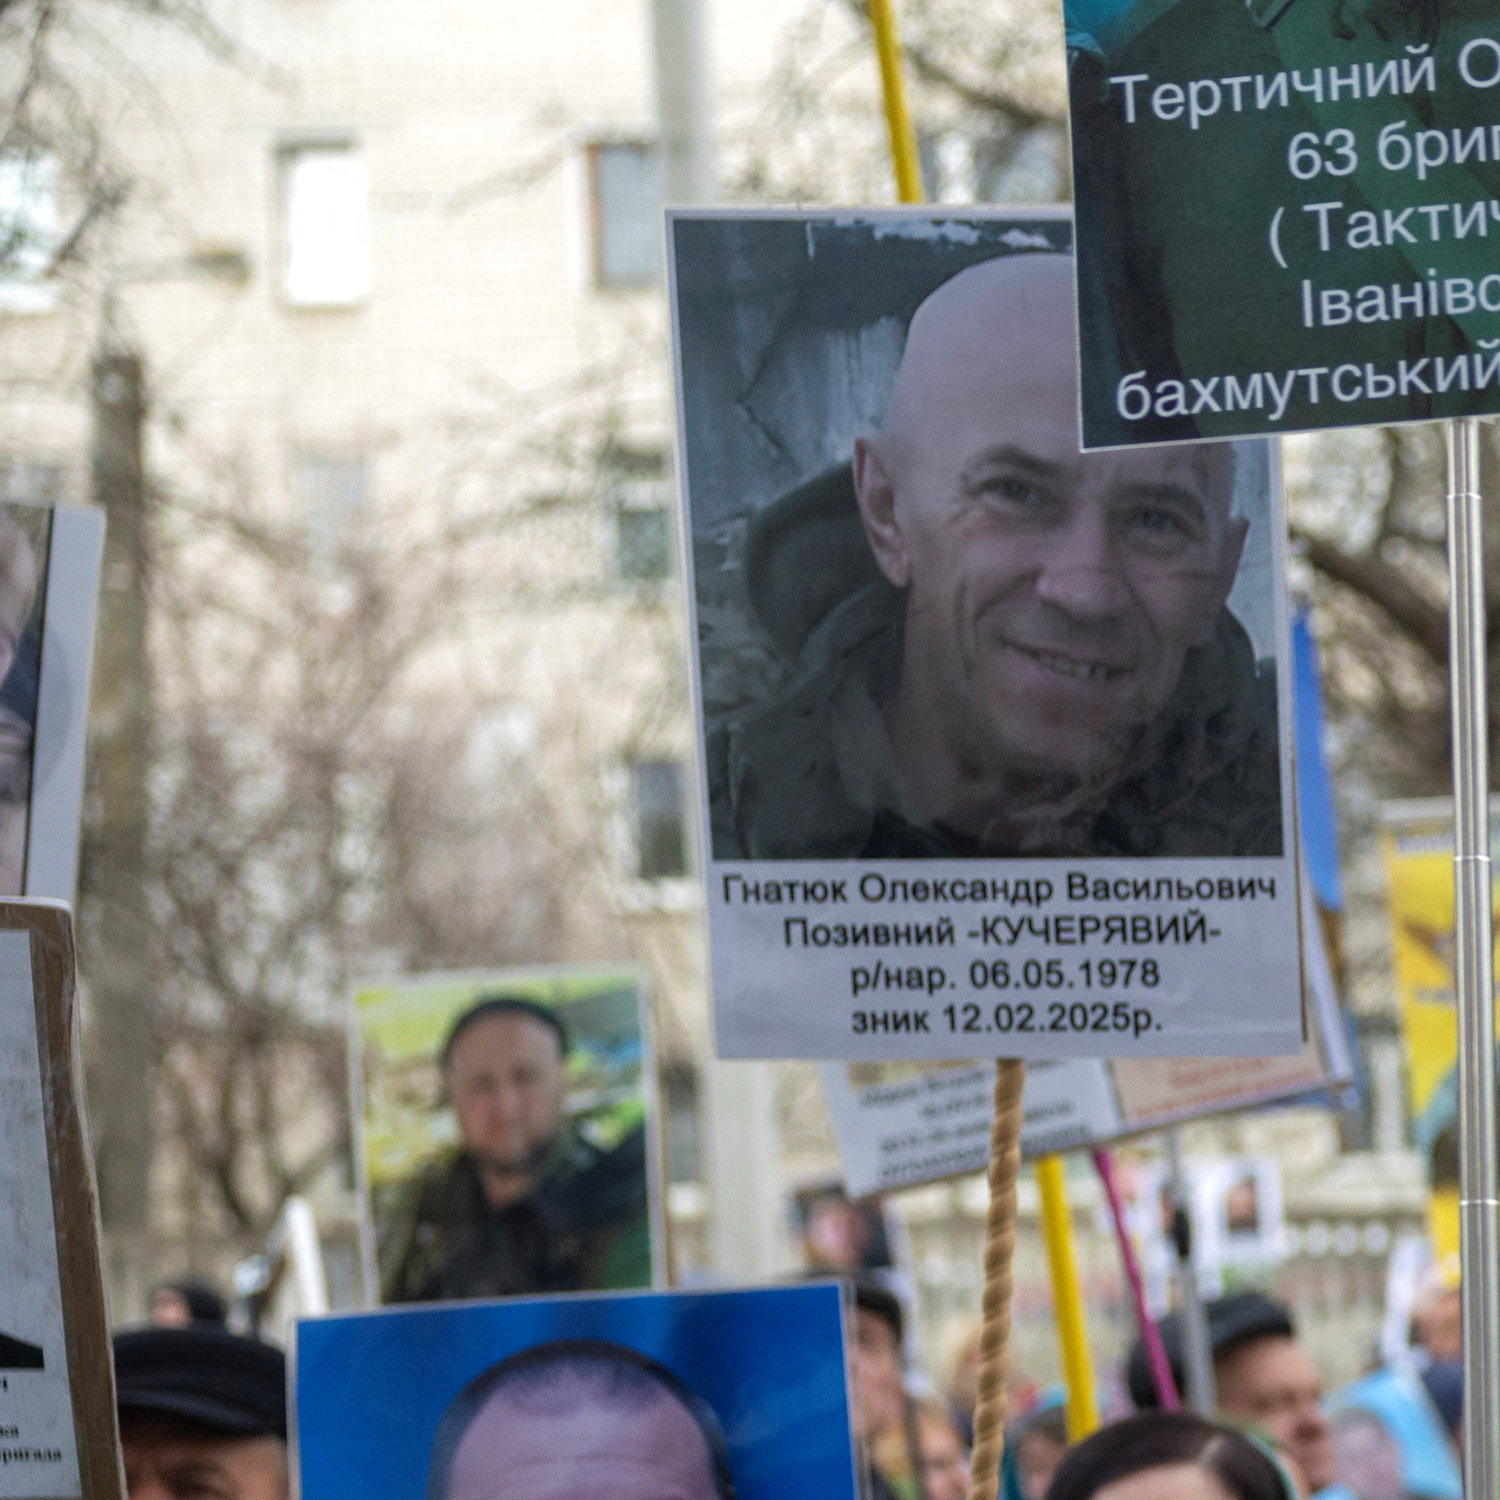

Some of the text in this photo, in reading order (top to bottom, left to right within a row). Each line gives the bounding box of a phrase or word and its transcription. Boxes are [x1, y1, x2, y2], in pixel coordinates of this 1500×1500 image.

[1110, 46, 1437, 130] Тертичний
[1287, 127, 1358, 181] 63
[723, 871, 1276, 908] Гнатюк Олександр Васильович
[784, 914, 956, 948] Позивний
[851, 959, 1160, 997] р/нар. 06.05.1978
[851, 1003, 1163, 1039] зник 12.02.2025р.
